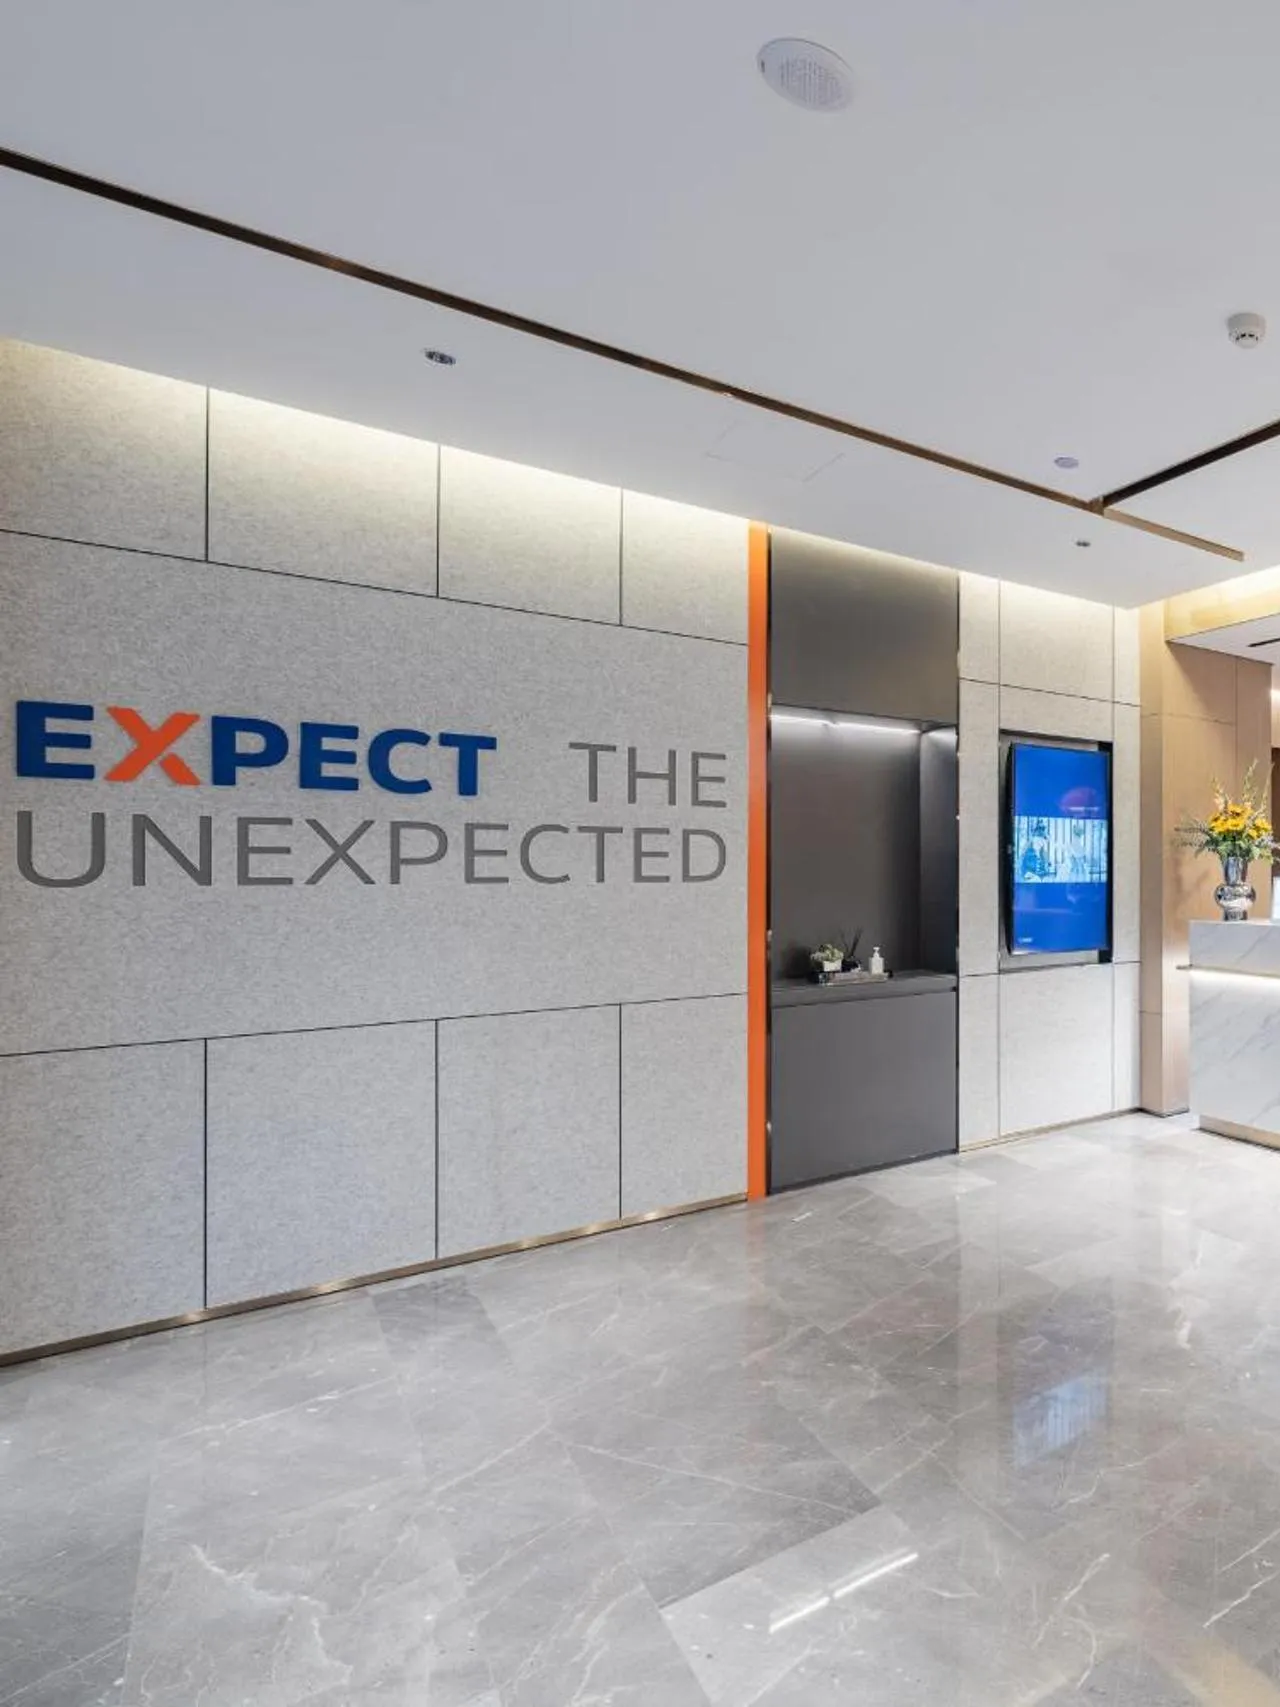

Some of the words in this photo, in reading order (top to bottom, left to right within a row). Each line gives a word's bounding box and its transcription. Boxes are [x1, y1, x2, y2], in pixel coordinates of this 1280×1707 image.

[16, 700, 497, 797] EXPECT
[568, 741, 728, 808] THE
[16, 810, 728, 888] UNEXPECTED
